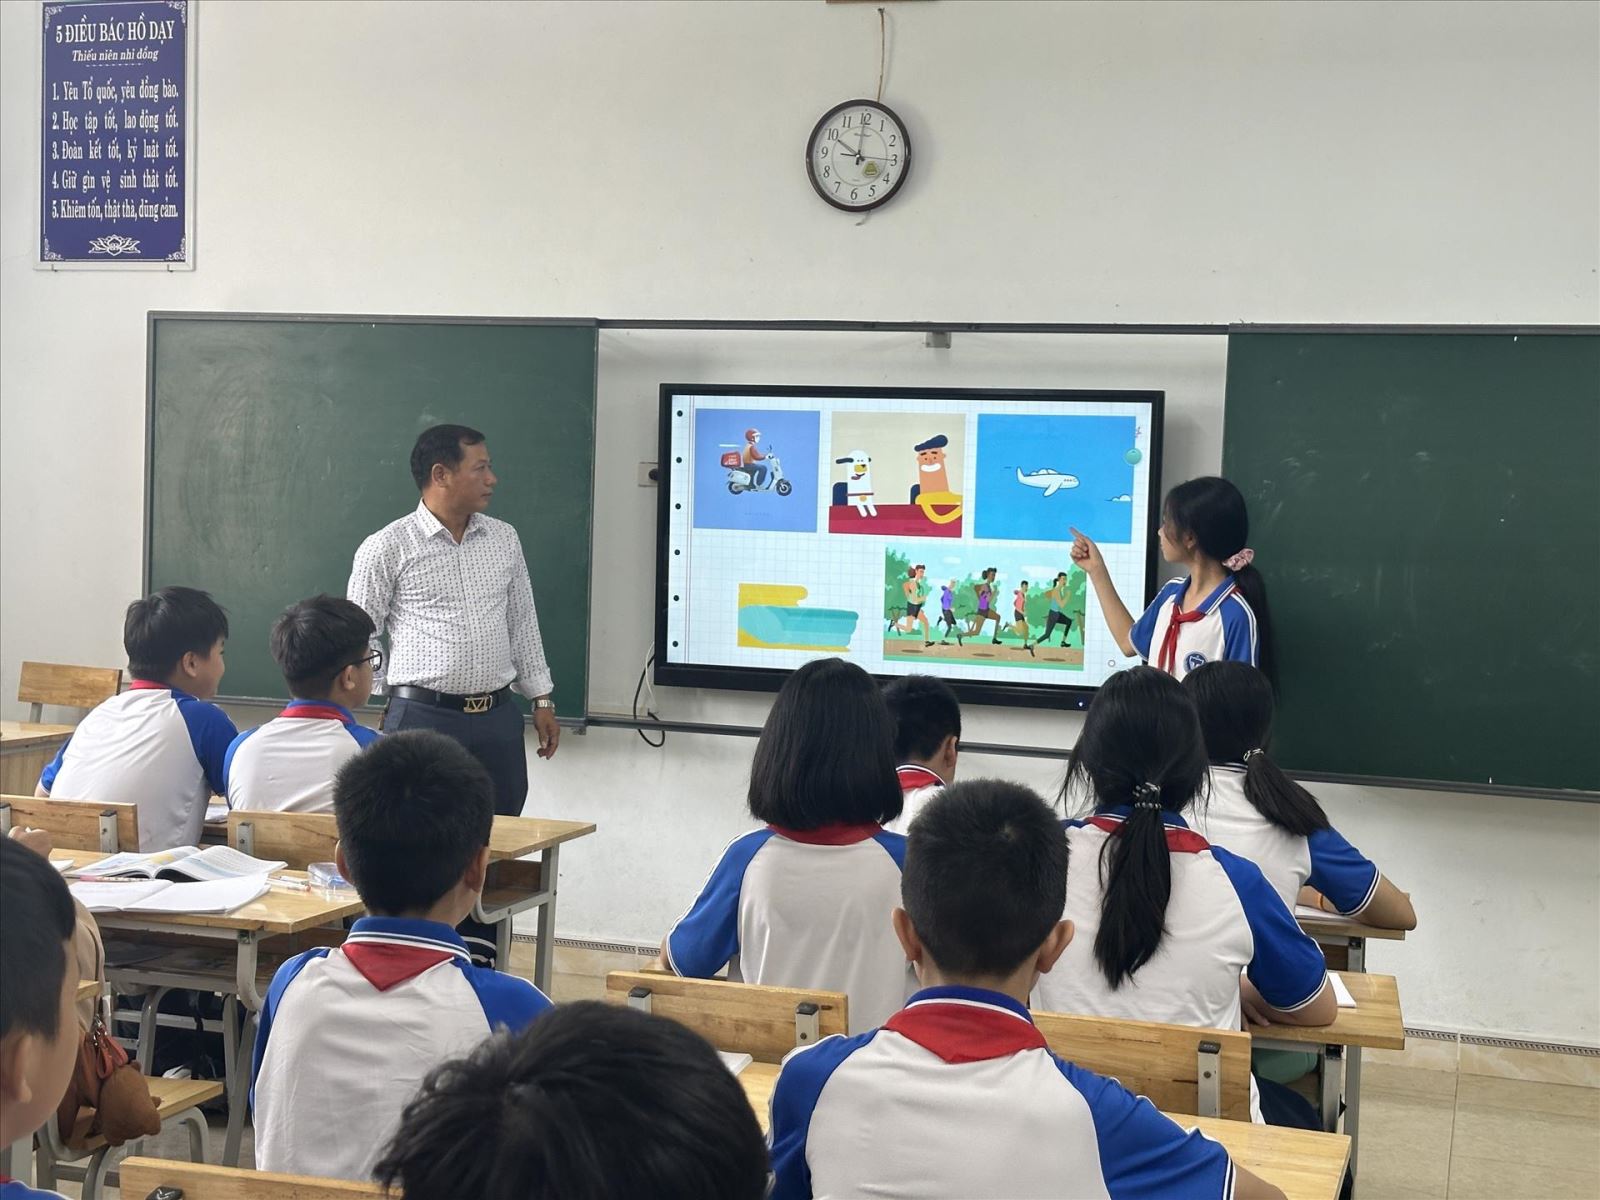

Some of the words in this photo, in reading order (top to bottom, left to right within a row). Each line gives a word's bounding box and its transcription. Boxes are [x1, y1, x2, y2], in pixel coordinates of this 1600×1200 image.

[56, 25, 63, 43] 5
[65, 14, 97, 43] ĐIỀU
[99, 17, 124, 42] BÁC
[127, 12, 146, 41] HỒ
[149, 20, 175, 45] DẠY
[72, 49, 97, 62] Thiếu
[99, 49, 118, 61] niên
[120, 48, 135, 60] nhi
[52, 83, 59, 100] 1.
[63, 80, 78, 101] Yêu
[96, 77, 118, 104] quốc,
[121, 80, 136, 103] yêu
[139, 75, 159, 102] đồng
[162, 78, 179, 98] bào.
[52, 111, 59, 130] 2.
[62, 111, 78, 135] Học
[85, 111, 98, 134] tập
[104, 107, 118, 132] tốt,
[124, 110, 136, 129] lao
[139, 109, 159, 133] động
[165, 105, 179, 128] tốt.
[842, 115, 852, 128] 11
[860, 113, 871, 125] 12
[880, 119, 885, 132] 1
[827, 128, 839, 141] 10
[888, 134, 897, 147] 2
[52, 141, 59, 160] 3.
[62, 140, 83, 160] Đoàn
[89, 138, 102, 160] kết
[108, 137, 122, 162] tốt,
[127, 138, 138, 163] kỷ
[143, 139, 159, 163] luật
[165, 136, 179, 158] tốt.
[821, 146, 829, 159] 9
[890, 154, 898, 166] 3
[823, 165, 830, 178] 8
[882, 172, 890, 184] 4
[52, 171, 59, 189] 4.
[62, 170, 77, 189] Giữ
[82, 170, 95, 193] gìn
[101, 170, 111, 193] vệ
[120, 169, 137, 188] sinh
[143, 169, 159, 193] thật
[165, 166, 179, 188] tốt.
[834, 181, 842, 193] 7
[868, 185, 876, 197] 5
[850, 188, 858, 200] 6
[52, 200, 59, 219] 5.
[60, 199, 86, 218] Khiêm
[87, 197, 103, 221] tốn,
[104, 199, 120, 223] thật
[122, 199, 138, 221] thà,
[139, 198, 159, 222] dũng
[160, 197, 179, 218] cảm.
